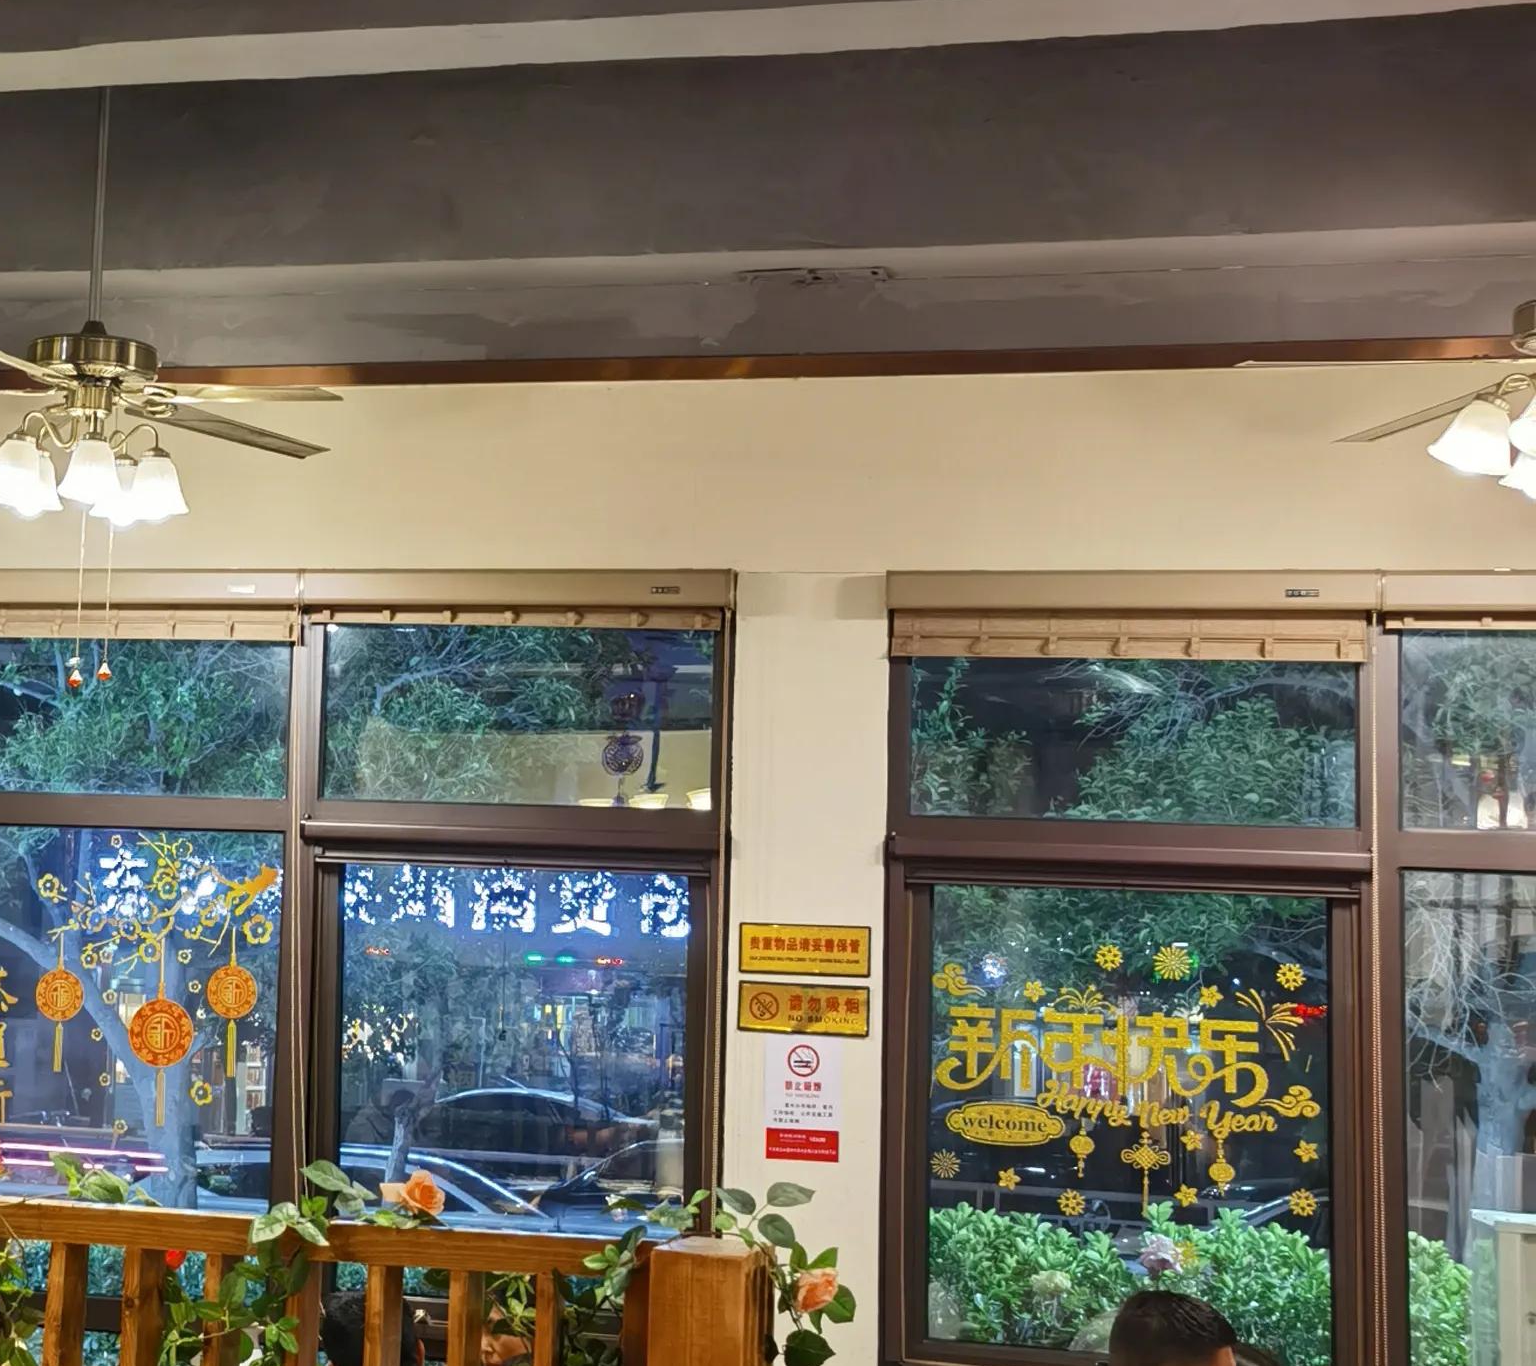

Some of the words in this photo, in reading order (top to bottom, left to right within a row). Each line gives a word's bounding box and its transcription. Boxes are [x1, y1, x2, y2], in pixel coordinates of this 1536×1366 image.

[750, 936, 860, 954] 贵重物品请妥善保管
[788, 994, 860, 1014] 请勿吸烟
[788, 1014, 803, 1023] NO
[936, 1003, 1269, 1108] 新年快乐
[1037, 1079, 1132, 1127] Happy
[1138, 1101, 1191, 1127] New
[1200, 1101, 1277, 1137] Year
[962, 1115, 1047, 1132] welcome
